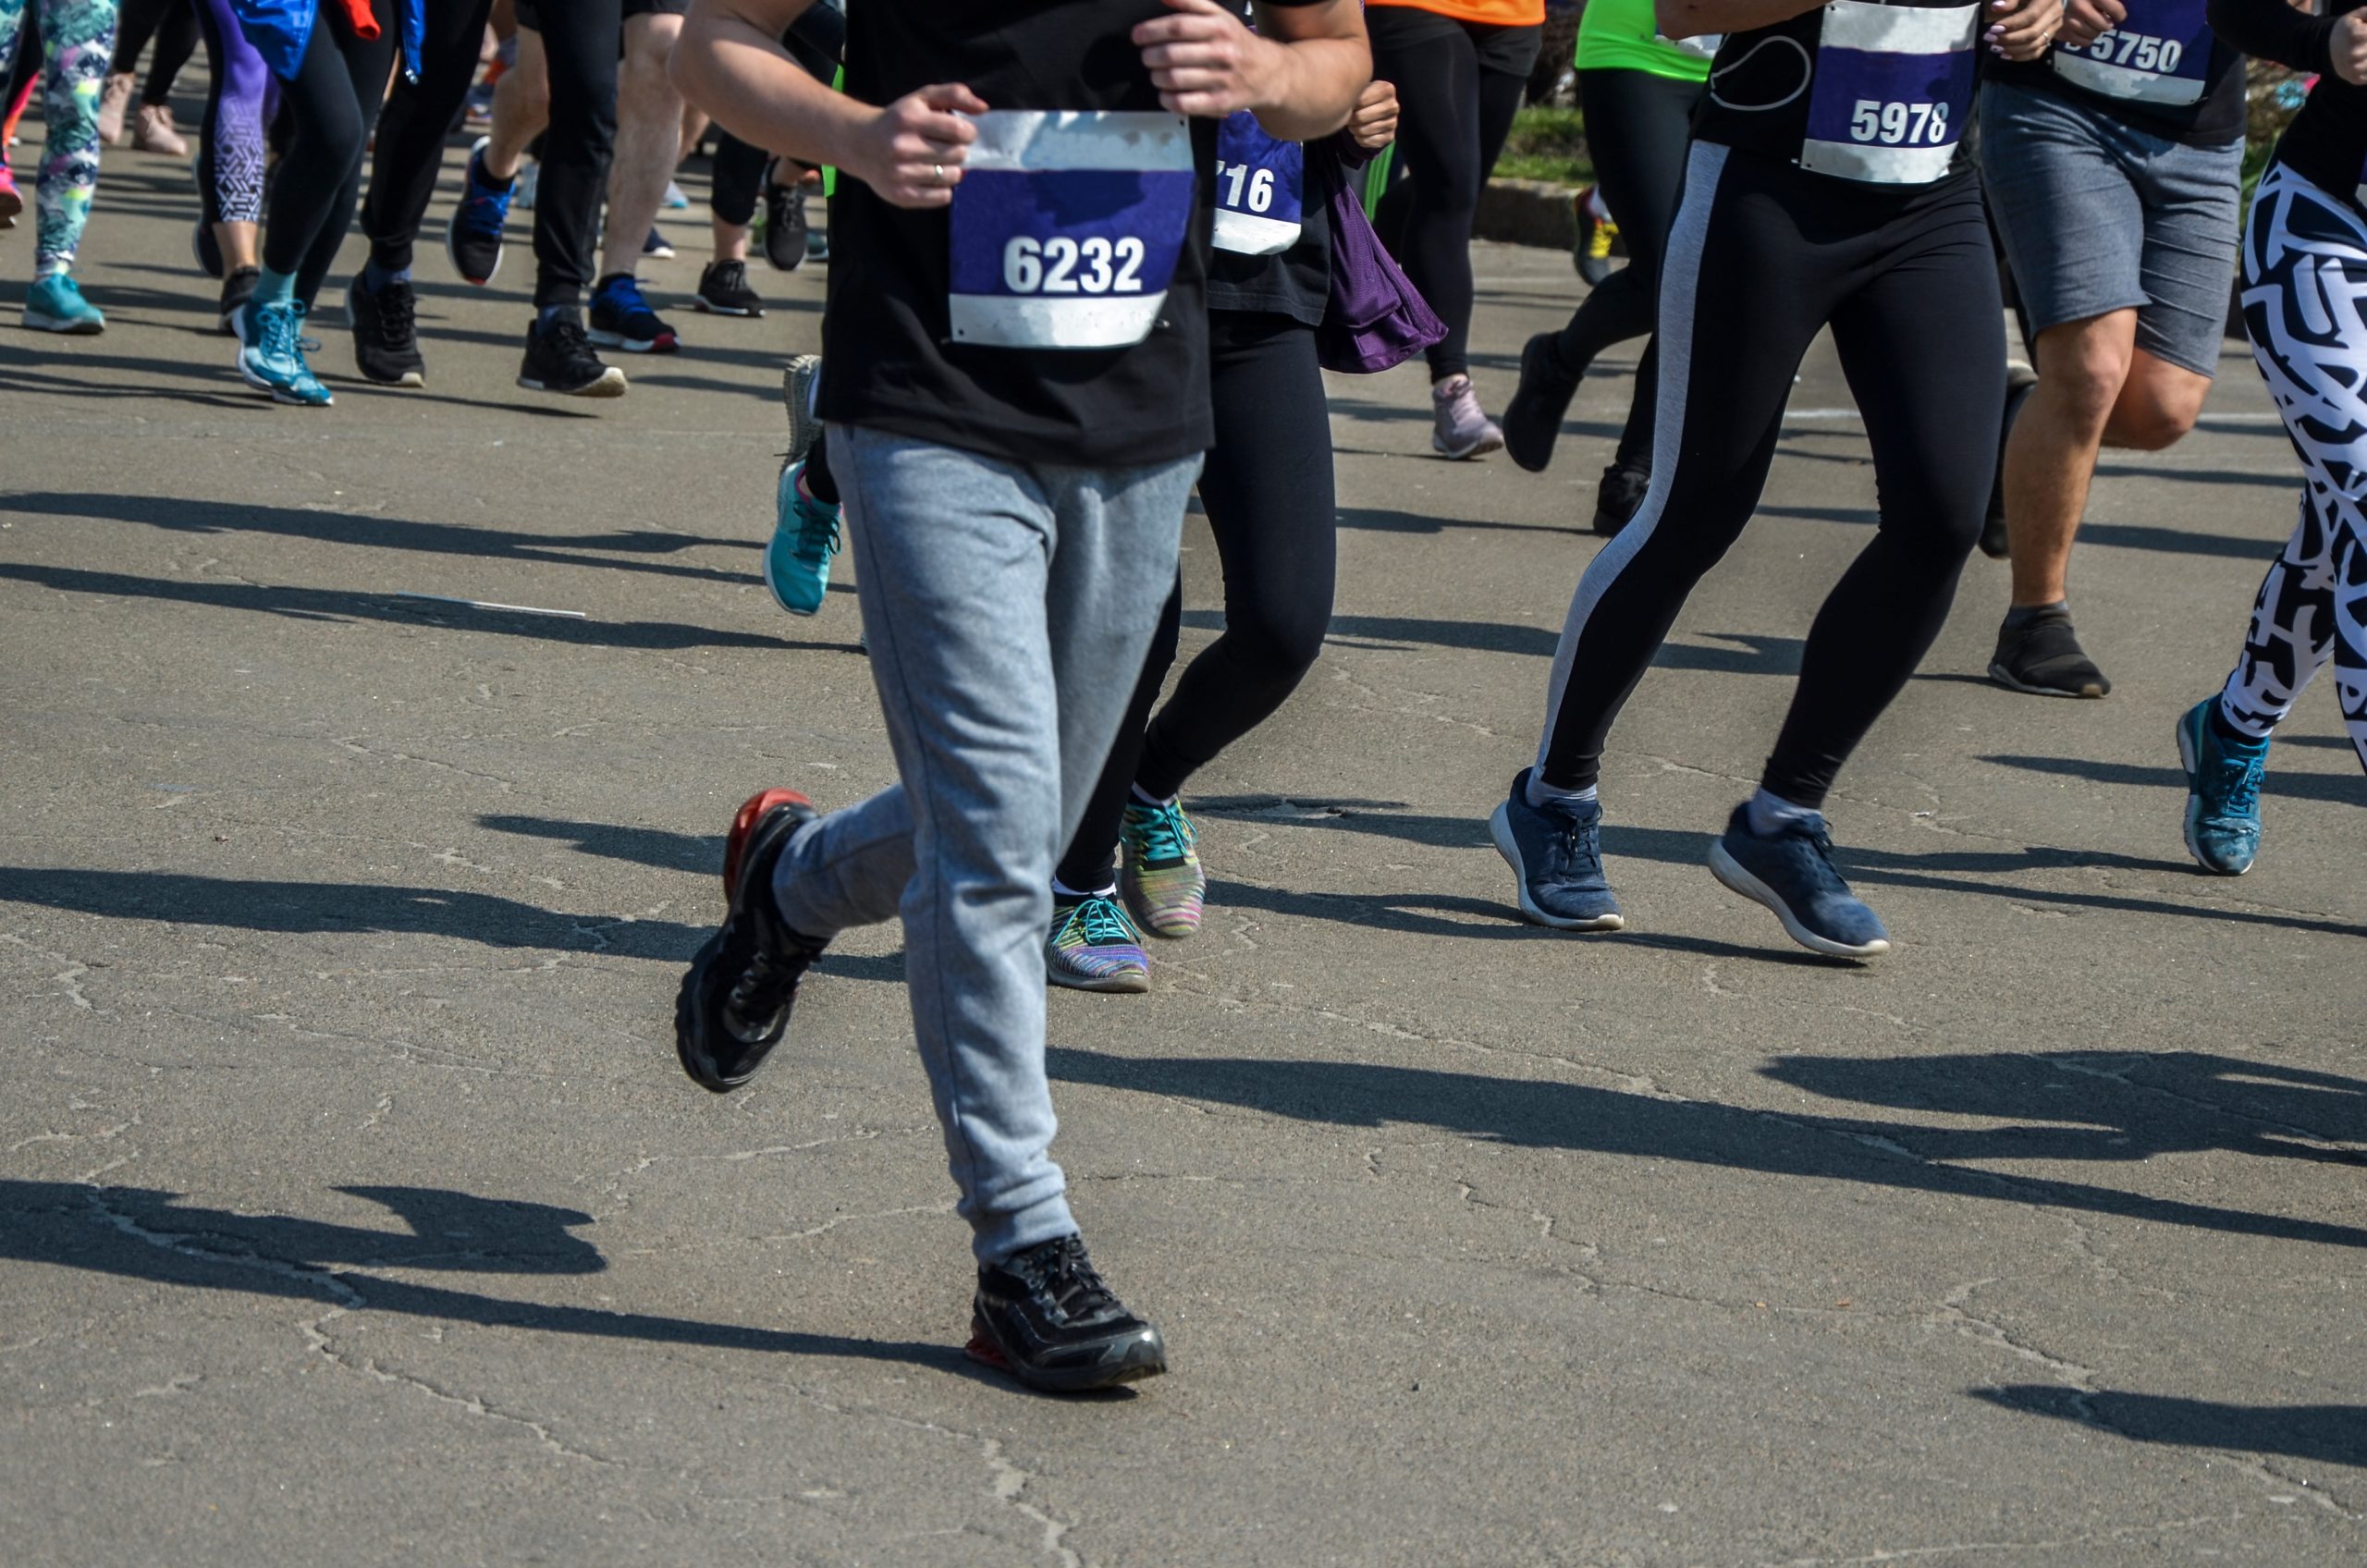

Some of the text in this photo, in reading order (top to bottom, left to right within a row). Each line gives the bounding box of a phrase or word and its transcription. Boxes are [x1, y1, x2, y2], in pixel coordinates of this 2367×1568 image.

[2091, 29, 2182, 73] 5750
[1850, 99, 1949, 143] 5978
[1216, 160, 1275, 213] 16
[1003, 235, 1145, 293] 6232
